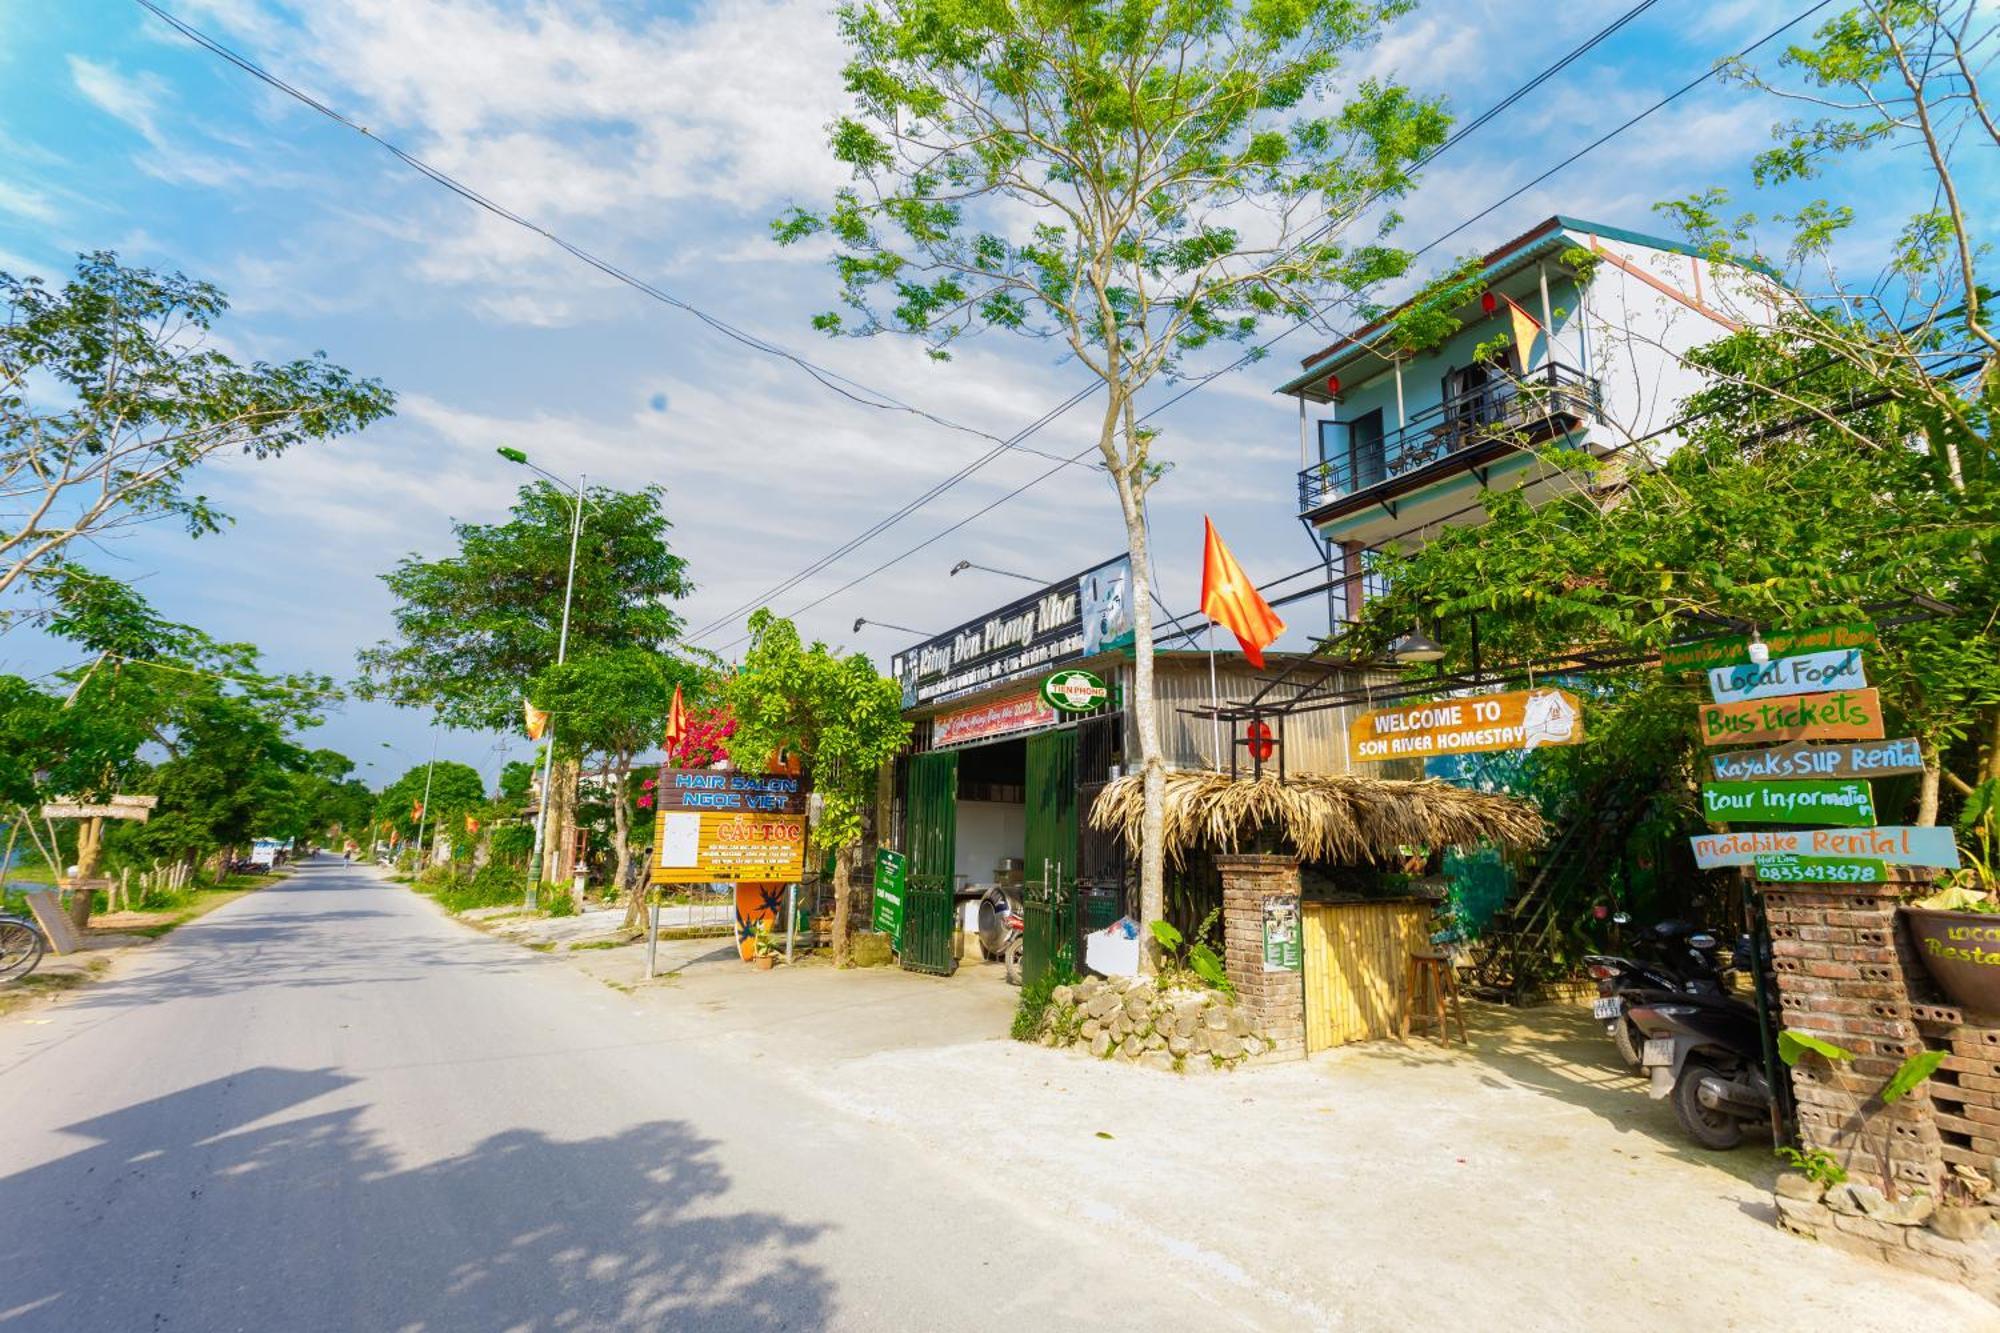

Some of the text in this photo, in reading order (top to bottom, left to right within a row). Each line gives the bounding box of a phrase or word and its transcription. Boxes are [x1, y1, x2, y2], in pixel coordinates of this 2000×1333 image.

[984, 611, 1035, 652] Phong
[1038, 592, 1076, 633] Nha
[1716, 650, 1858, 693] Local Food
[1074, 686, 1105, 696] PHONG
[1375, 700, 1501, 734] WELCOME TO
[1707, 693, 1870, 737] Bus tickets
[1358, 726, 1525, 756] SON RIVER HOMESTAY
[1852, 742, 1922, 771] Rental
[675, 774, 797, 793] HAIR SALON
[683, 792, 741, 810] NGỌC
[762, 820, 801, 842] TÓC
[1813, 830, 1910, 855] Rental
